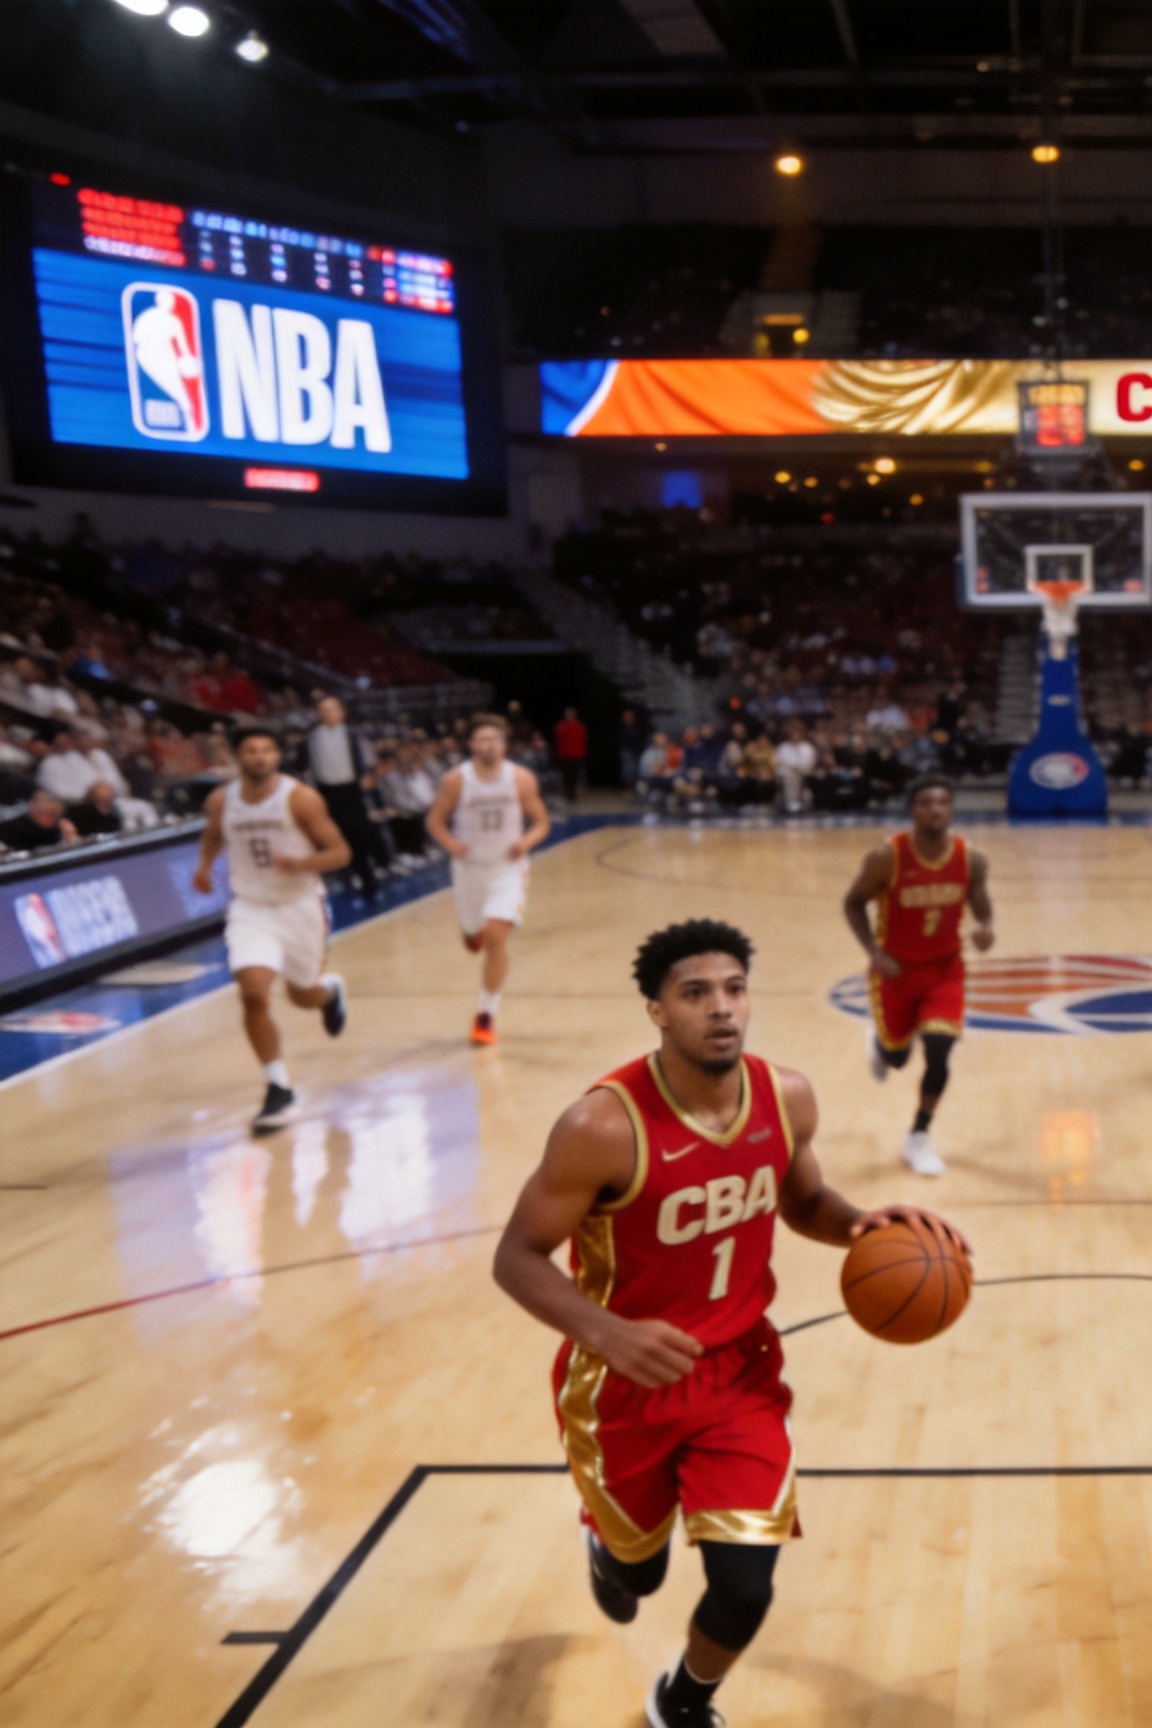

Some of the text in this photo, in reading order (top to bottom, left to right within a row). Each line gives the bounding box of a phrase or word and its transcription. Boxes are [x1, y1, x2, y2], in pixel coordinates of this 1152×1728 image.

[212, 298, 392, 453] NBA
[656, 1164, 777, 1245] CBA
[708, 1236, 736, 1301] 1
